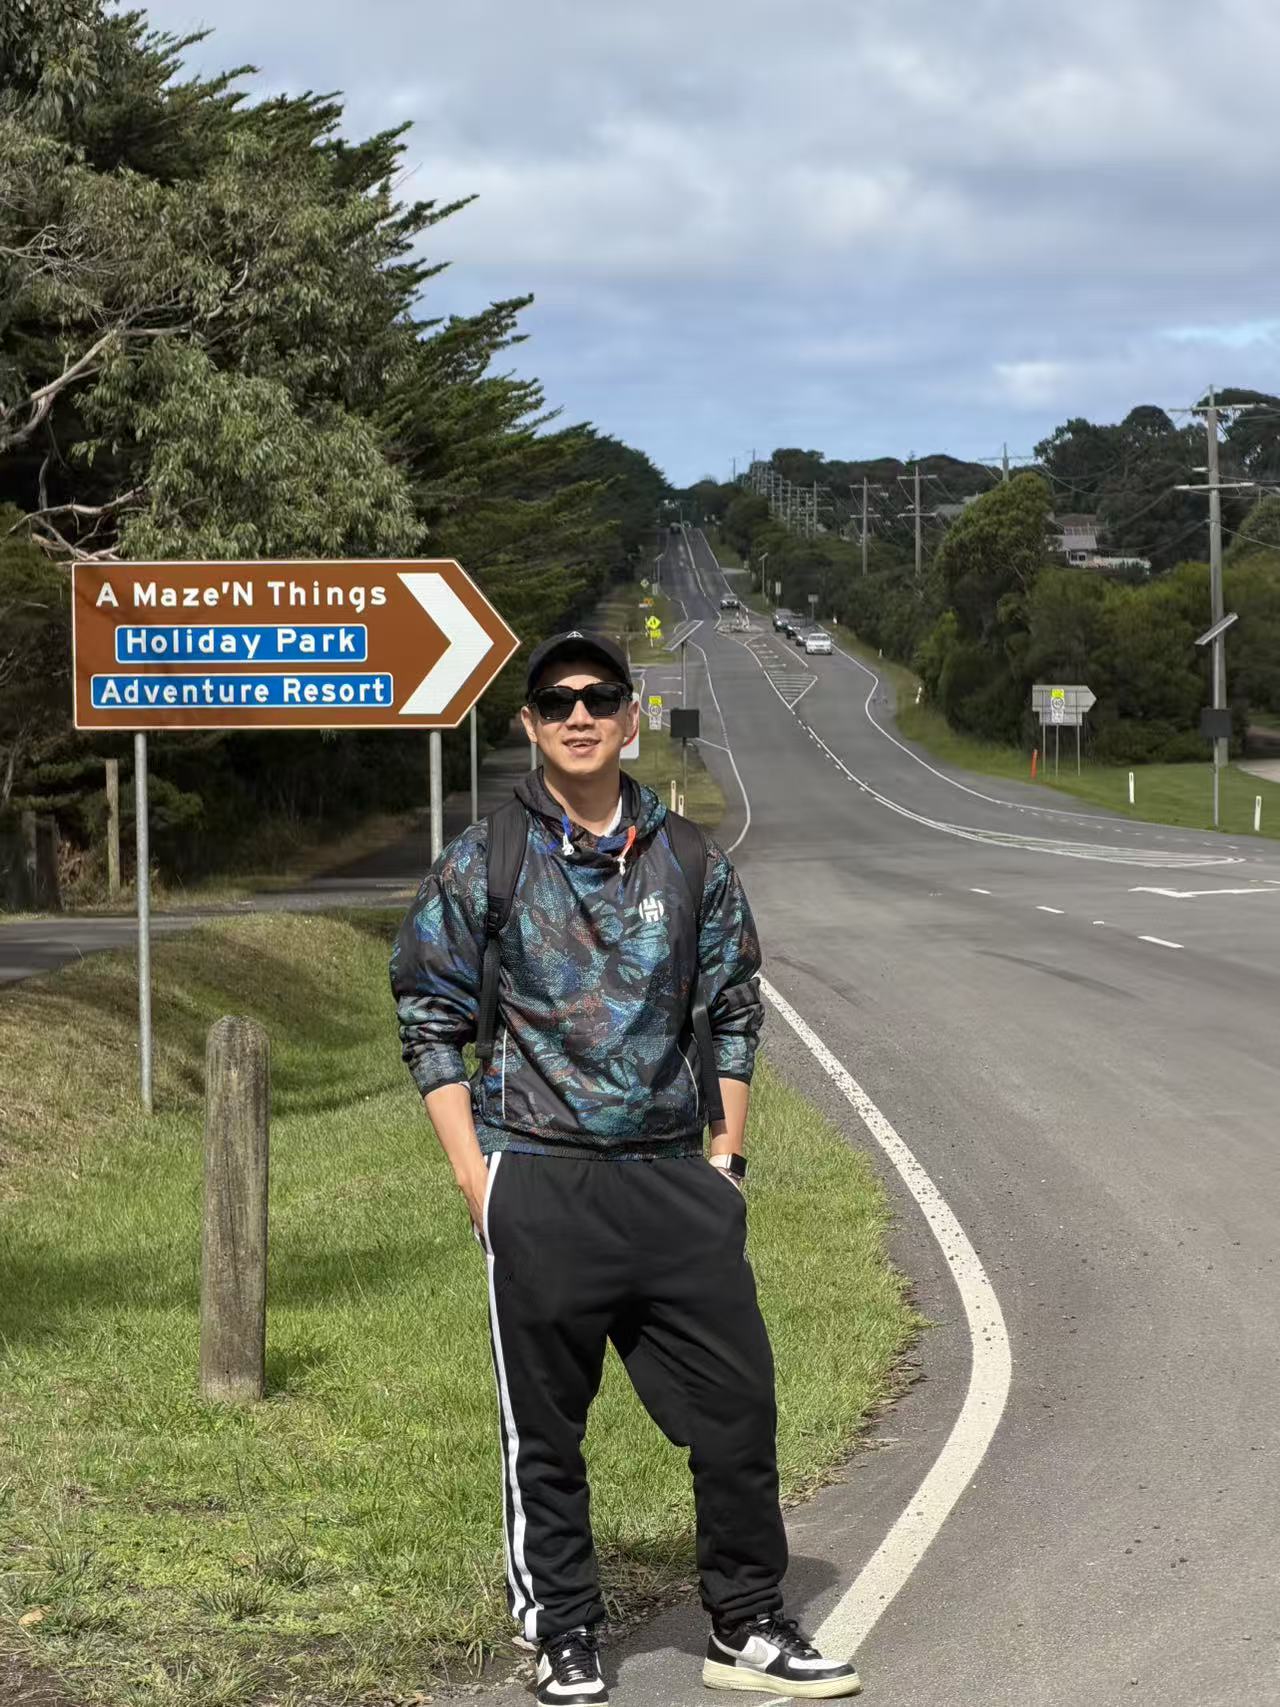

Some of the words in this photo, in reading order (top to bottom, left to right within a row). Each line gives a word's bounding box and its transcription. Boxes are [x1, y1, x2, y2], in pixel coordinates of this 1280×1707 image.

[95, 582, 119, 607] A
[133, 581, 253, 607] Maze'N
[267, 580, 387, 613] Things
[126, 628, 261, 659] Holiday
[277, 627, 356, 653] Park
[100, 678, 269, 704] Adventure
[283, 677, 385, 703] Resort
